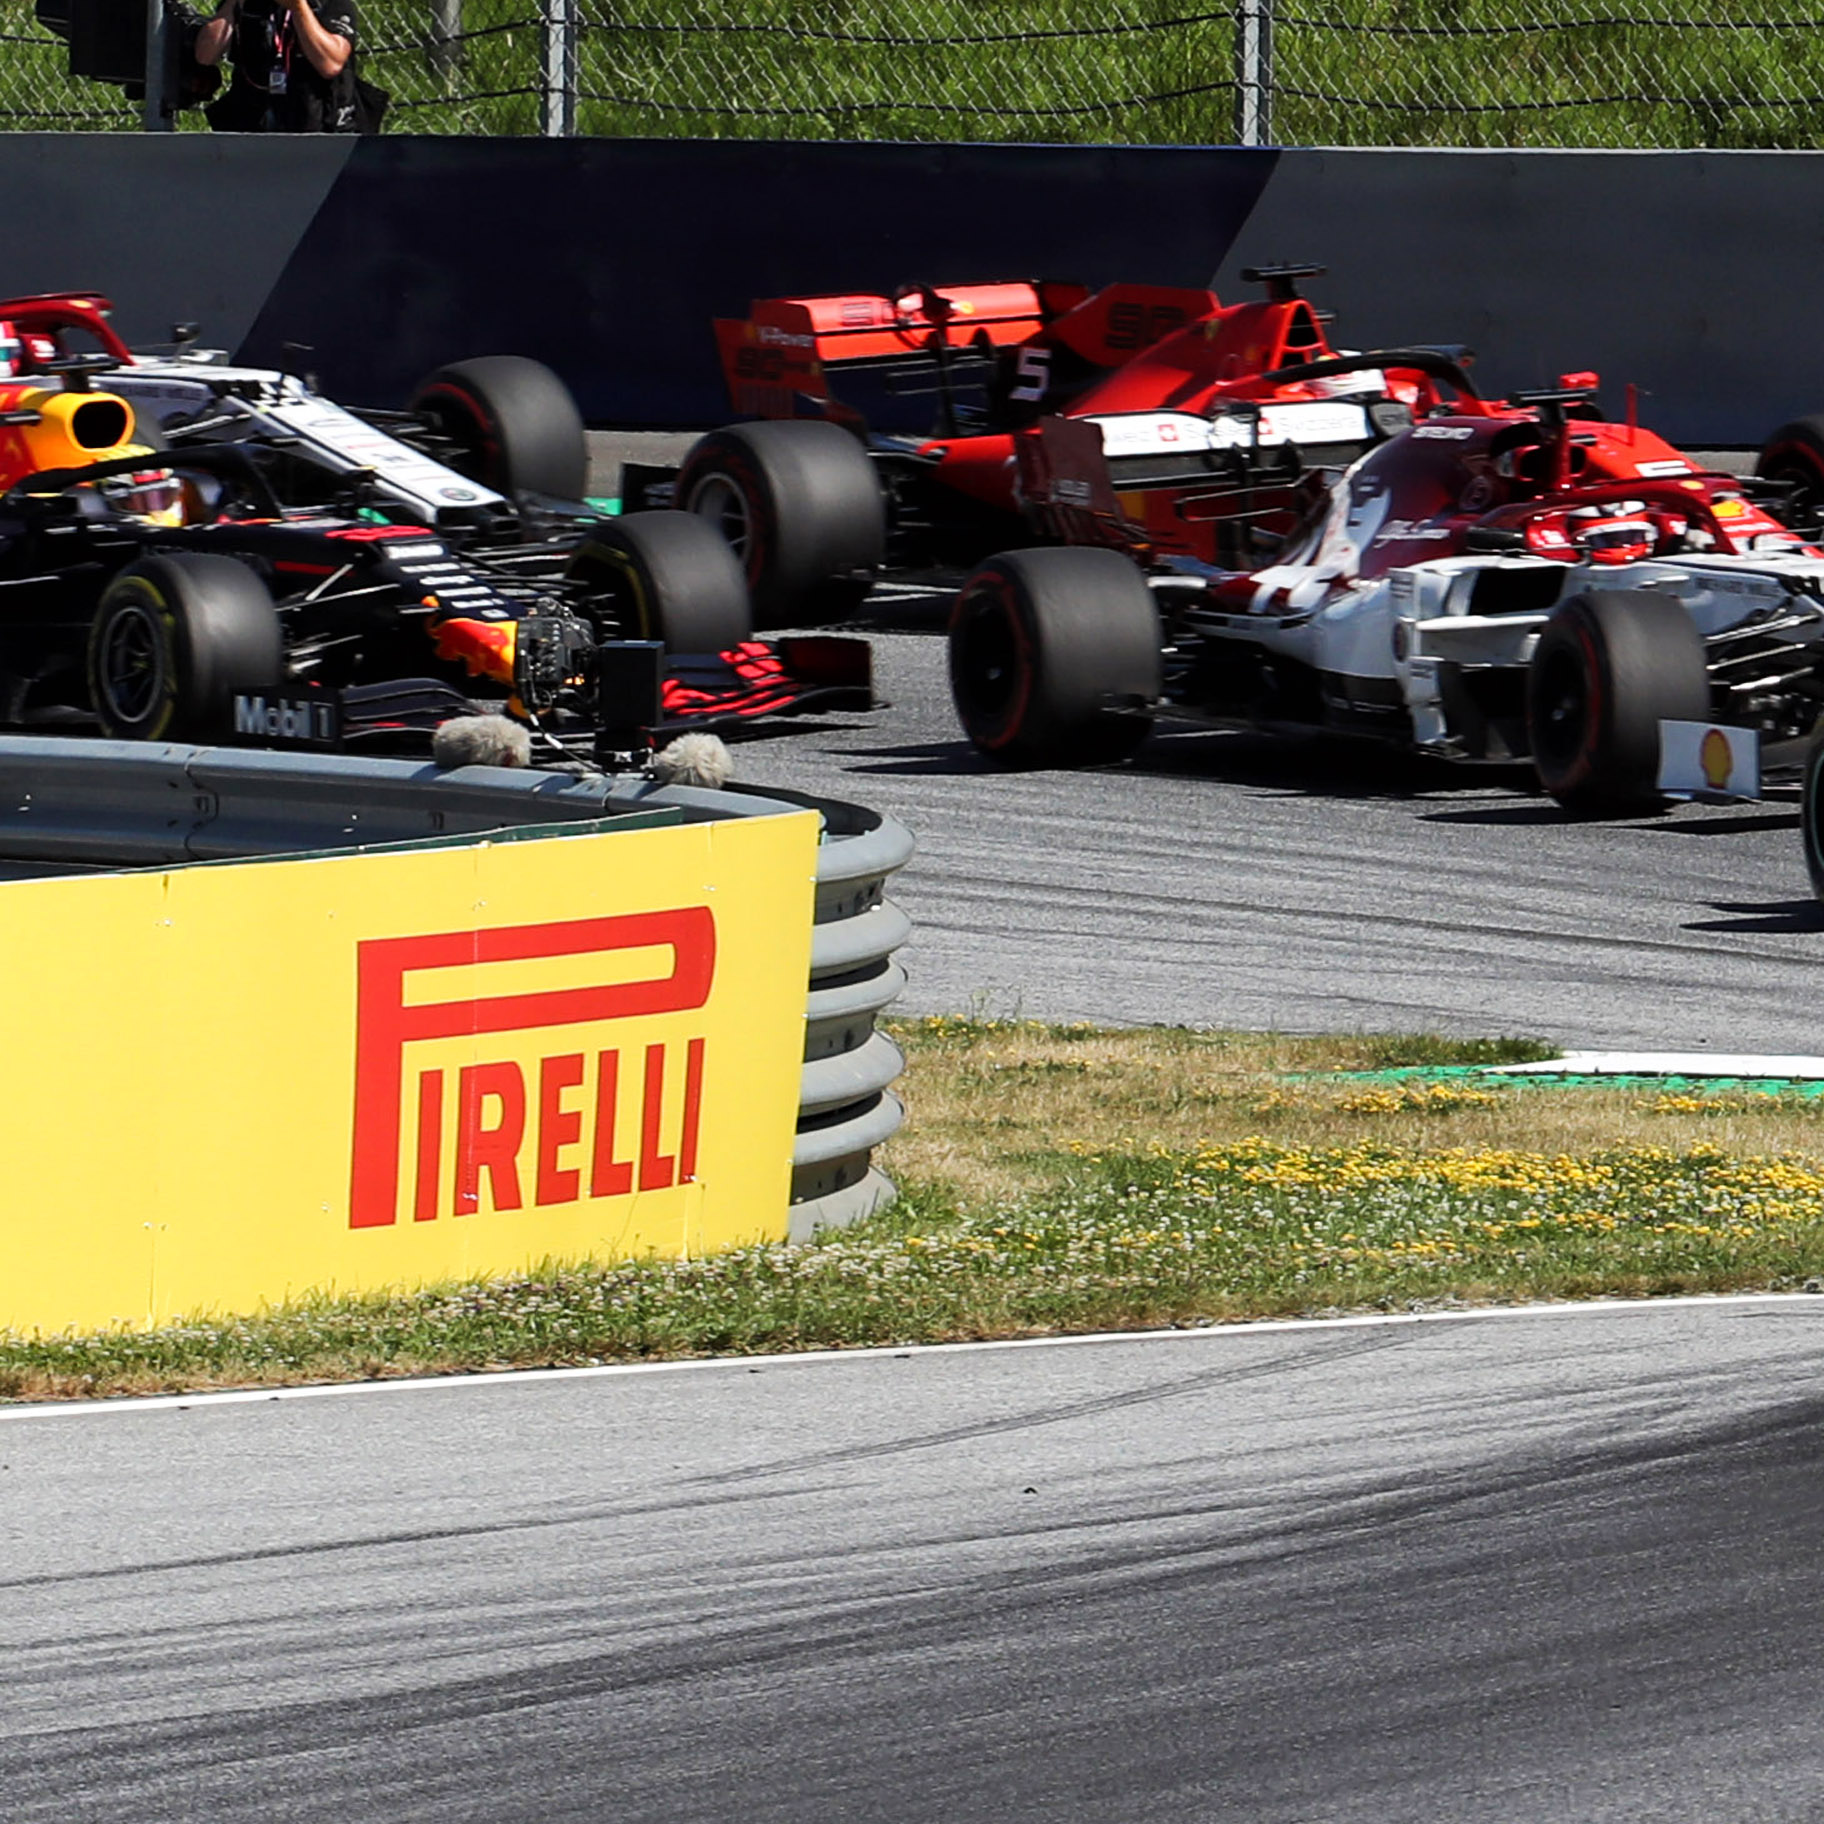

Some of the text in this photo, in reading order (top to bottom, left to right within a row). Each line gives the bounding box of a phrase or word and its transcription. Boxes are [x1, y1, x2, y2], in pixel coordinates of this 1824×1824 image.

[1009, 346, 1052, 401] 5
[235, 694, 312, 740] Mobil
[348, 906, 717, 1230] PIRELLI
